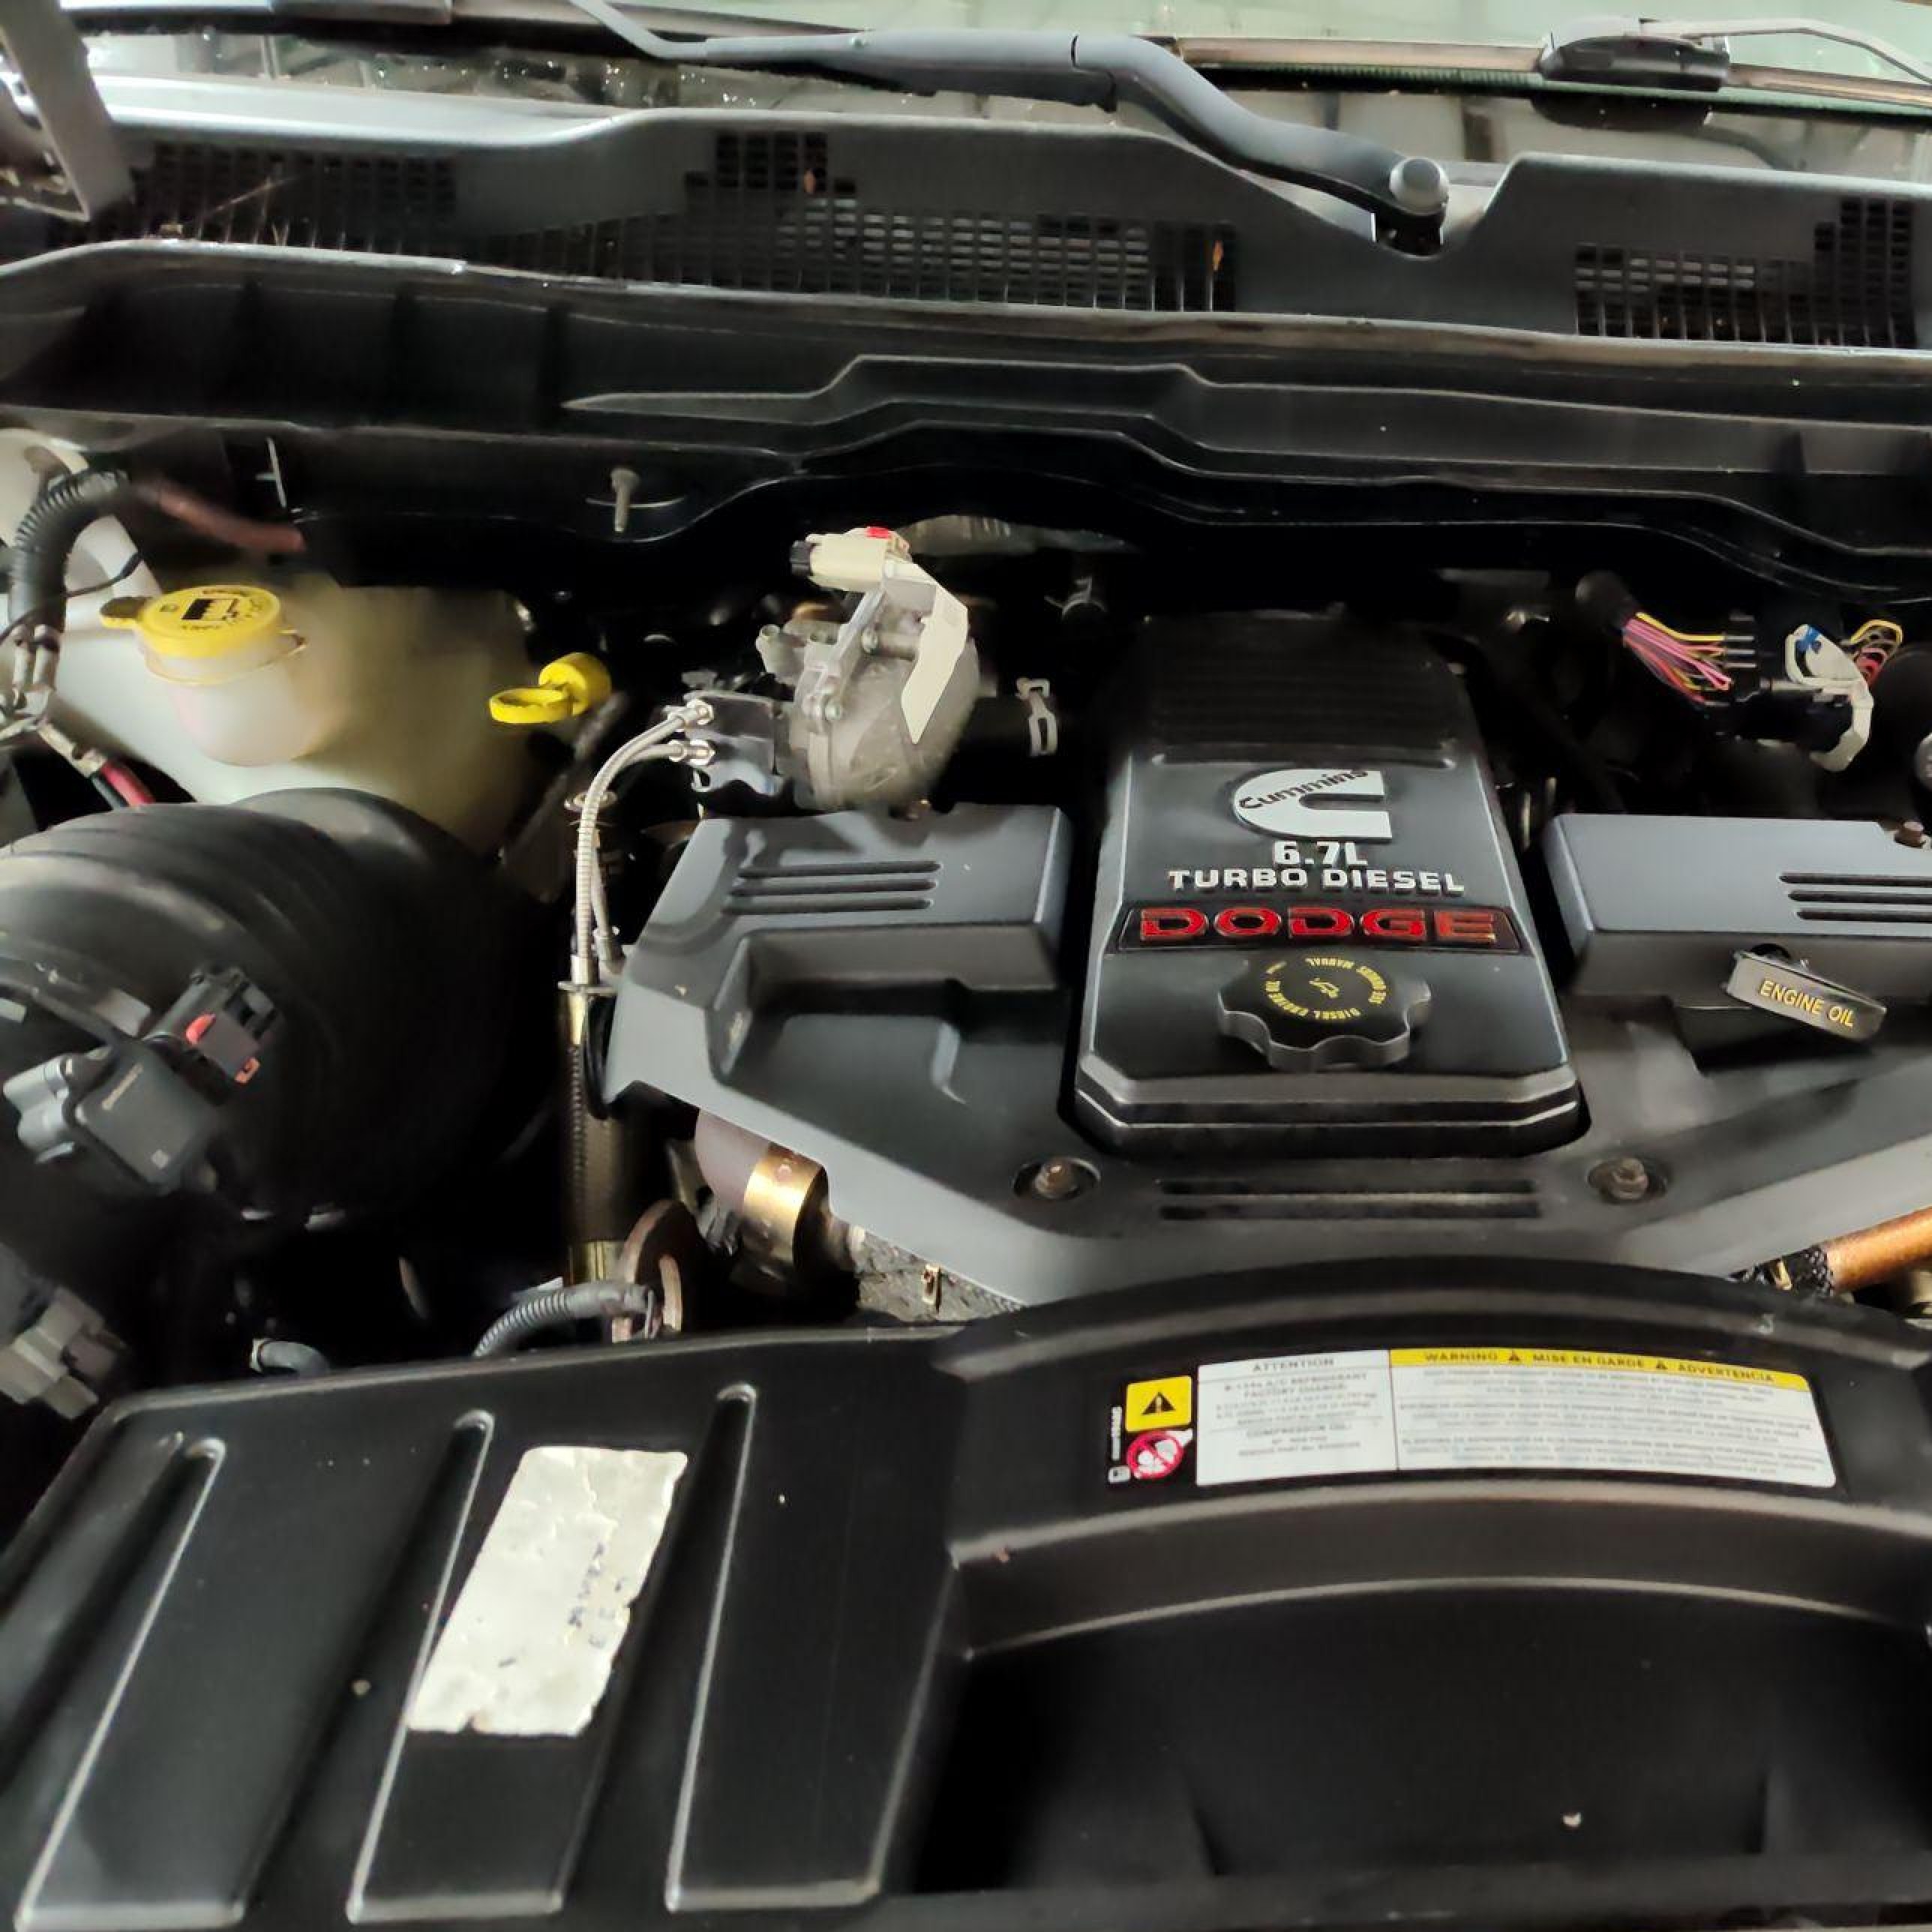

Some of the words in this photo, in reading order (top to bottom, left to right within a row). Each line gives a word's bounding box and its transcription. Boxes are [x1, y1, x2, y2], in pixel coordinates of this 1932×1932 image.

[1238, 770, 1368, 809] Cummins
[1274, 841, 1369, 866] 6.7L
[1168, 868, 1310, 890] TURBO
[1322, 868, 1465, 893] DIESEL
[1139, 906, 1497, 942] DODGE
[1759, 977, 1825, 1016] ENGINE
[1828, 1005, 1854, 1028] OIL
[1252, 1358, 1335, 1372] ATTENTION
[1425, 1352, 1498, 1362] WARNING
[1532, 1353, 1567, 1364] MISE
[1573, 1354, 1592, 1364] EN
[1598, 1355, 1645, 1368] GARDE
[1678, 1363, 1774, 1382] ADVERTENCIA
